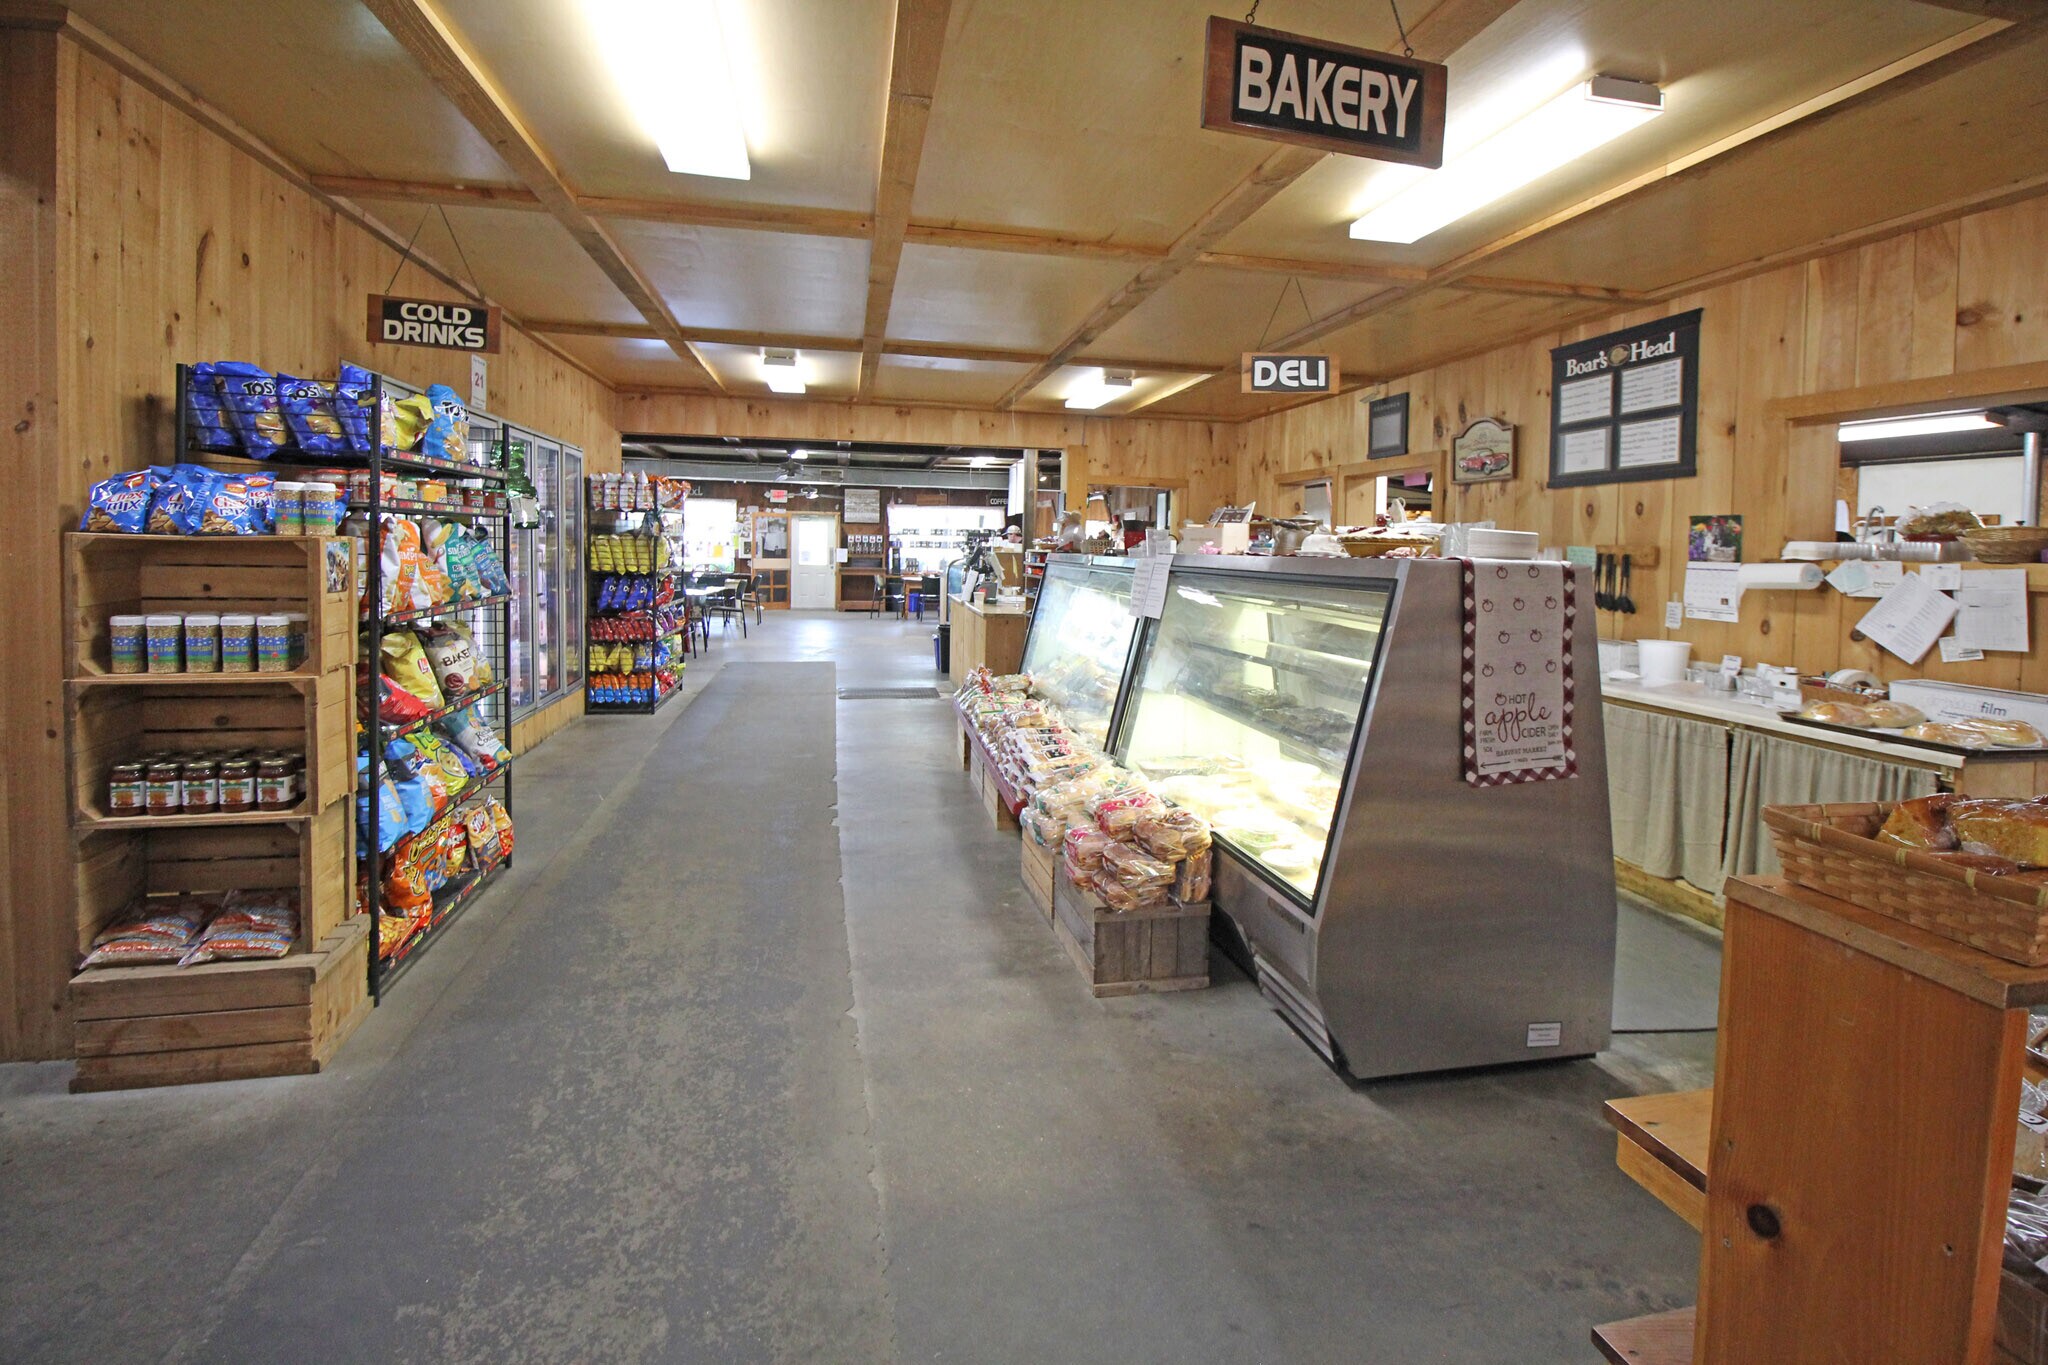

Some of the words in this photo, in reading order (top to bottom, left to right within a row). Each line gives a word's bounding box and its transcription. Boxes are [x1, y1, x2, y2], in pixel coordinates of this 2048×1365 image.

[1238, 45, 1418, 138] BAKERY
[400, 302, 472, 325] COLD
[383, 319, 485, 348] DRINKS
[1566, 350, 1608, 378] Boar's
[1629, 331, 1676, 362] Head
[474, 372, 484, 389] 21
[1253, 359, 1326, 387] DELI
[1508, 694, 1527, 704] HOT
[1980, 701, 2007, 717] film
[1485, 692, 1552, 743] apple
[1521, 726, 1547, 738] CIDER
[1522, 746, 1547, 754] MARKET
